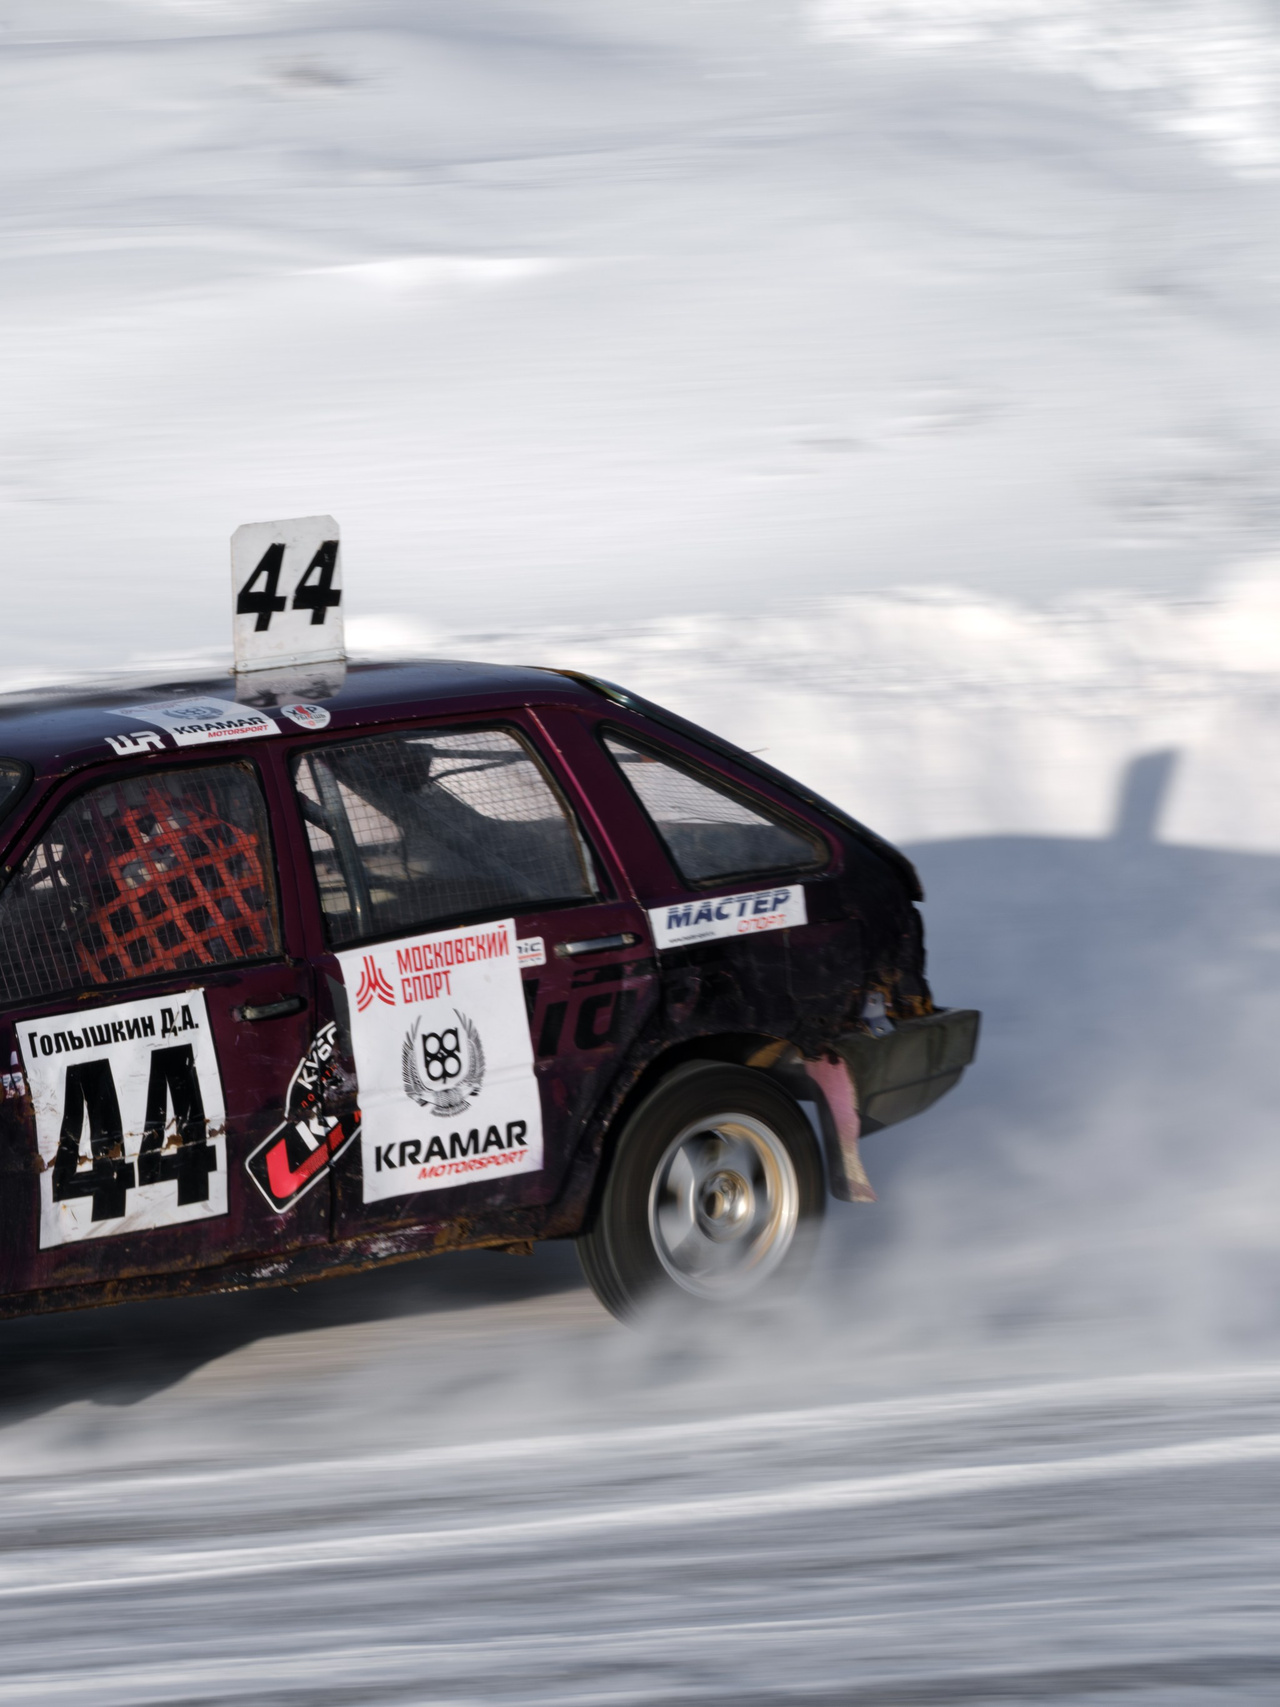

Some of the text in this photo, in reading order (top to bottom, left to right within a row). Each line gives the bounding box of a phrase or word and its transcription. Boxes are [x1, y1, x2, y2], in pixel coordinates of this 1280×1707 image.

[236, 539, 342, 632] 44
[173, 716, 266, 735] KRAMAR
[207, 724, 269, 739] MOTORSPORT
[666, 888, 791, 930] МАСТЕР
[396, 924, 509, 975] МОСКОВСКИЙ
[400, 970, 451, 1004] СПОРТ
[28, 1004, 199, 1058] Голышкин Д.А.
[52, 1043, 218, 1222] 44
[375, 1120, 528, 1172] KRAMAR
[417, 1149, 528, 1180] MOTORSPORT
